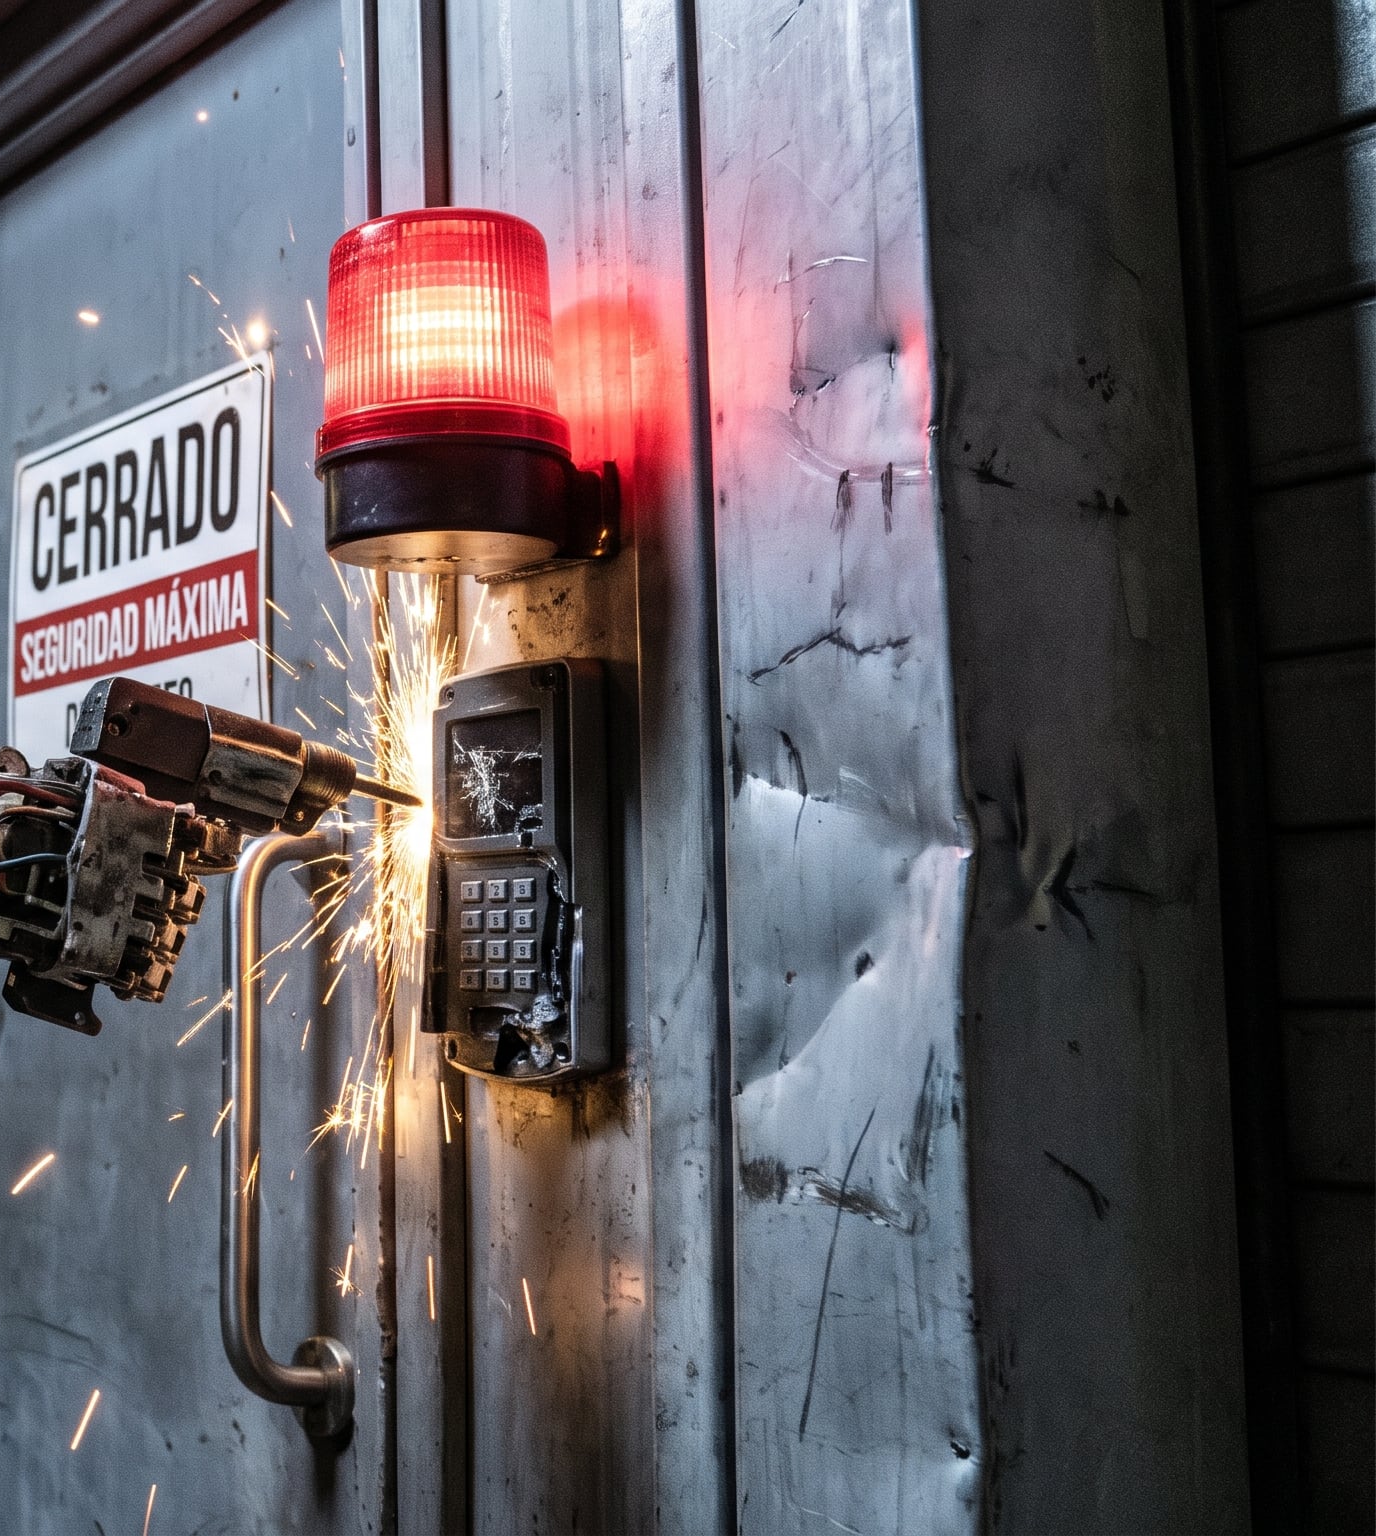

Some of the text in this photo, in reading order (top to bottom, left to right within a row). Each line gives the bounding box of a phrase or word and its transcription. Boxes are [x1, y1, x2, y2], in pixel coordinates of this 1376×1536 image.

[32, 407, 240, 592] CERRADO
[21, 577, 247, 683] SEGURIDAD MÁXIMA
